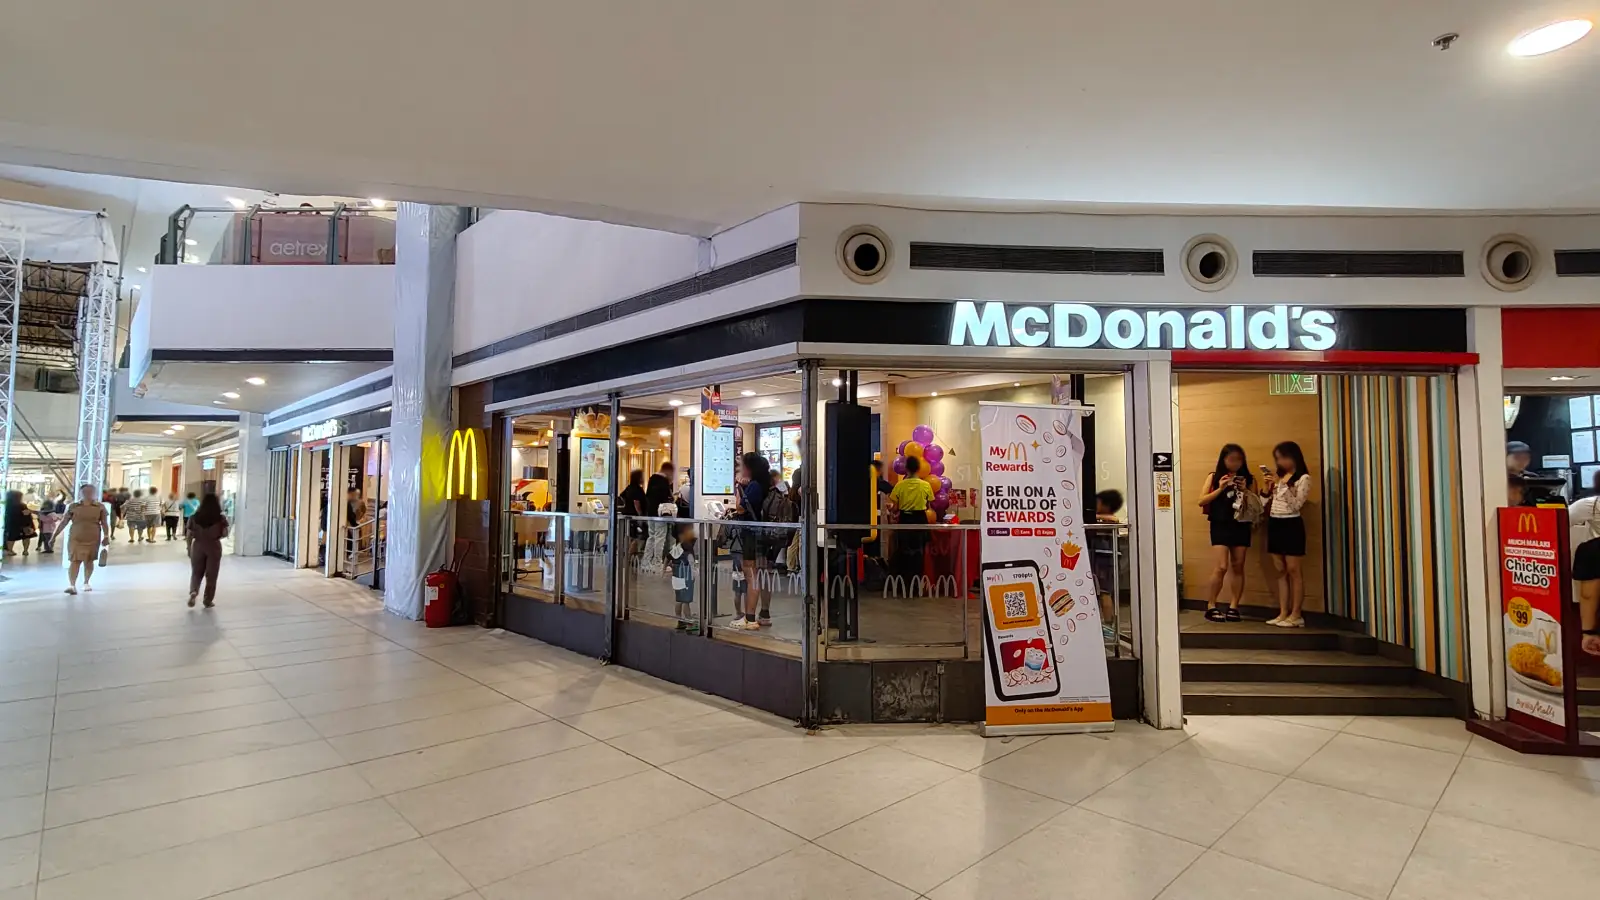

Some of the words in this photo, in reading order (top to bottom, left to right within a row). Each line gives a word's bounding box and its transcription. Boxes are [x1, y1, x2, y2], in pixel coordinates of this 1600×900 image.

[270, 239, 328, 256] aetrex
[949, 301, 1337, 350] McDonald's
[990, 446, 1007, 459] My
[985, 461, 1034, 472] Rewards
[986, 485, 1004, 497] BE
[1007, 485, 1020, 497] IN
[1023, 486, 1043, 498] ON
[1046, 486, 1056, 497] A
[986, 498, 1036, 510] WORLD
[1039, 499, 1058, 510] OF
[986, 511, 1055, 523] REWARDS
[1505, 558, 1555, 575] Chicken
[1513, 571, 1549, 587] McDo
